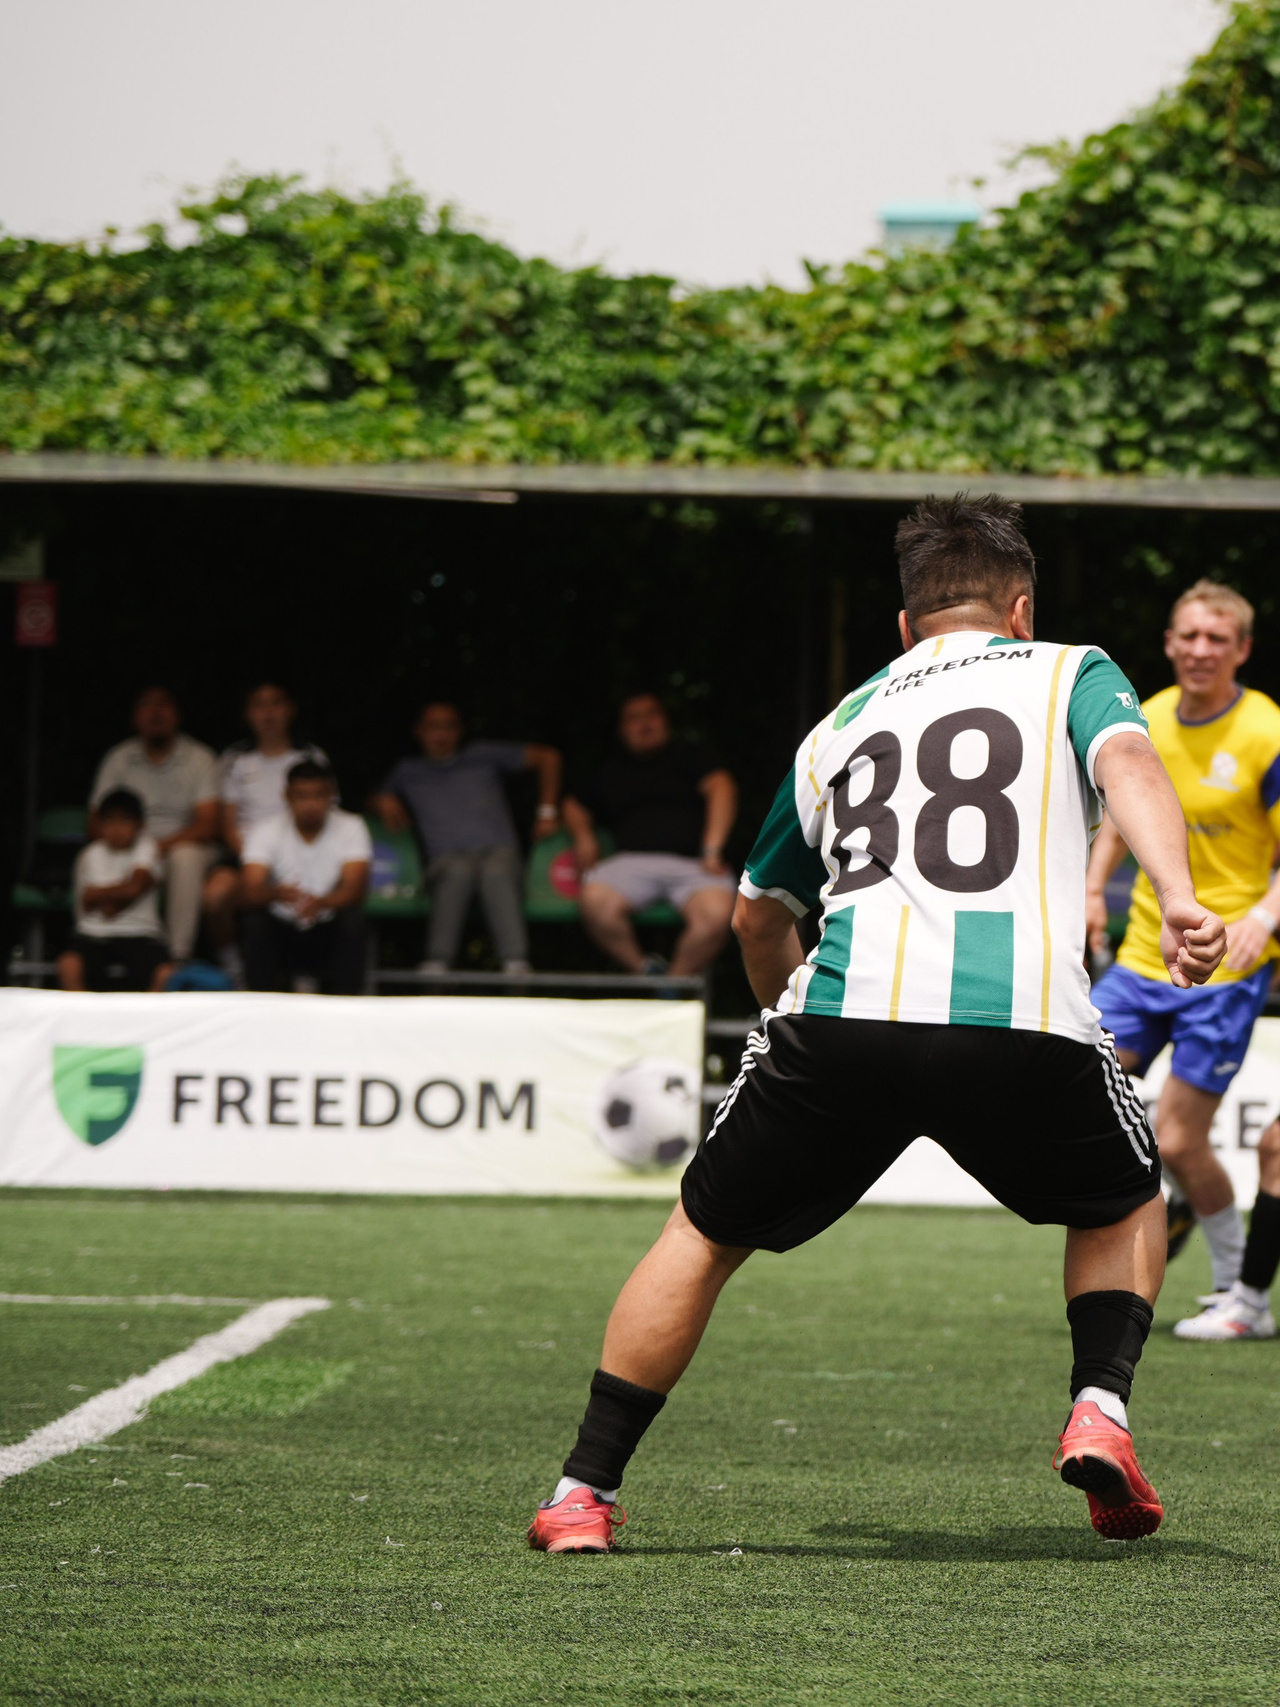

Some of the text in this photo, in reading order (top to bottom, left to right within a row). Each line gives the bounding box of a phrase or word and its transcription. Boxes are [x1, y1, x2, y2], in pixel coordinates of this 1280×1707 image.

[883, 677, 926, 698] LIFE
[888, 648, 1035, 688] FREEDOM
[828, 706, 1024, 897] 88
[172, 1073, 536, 1132] FREEDOM
